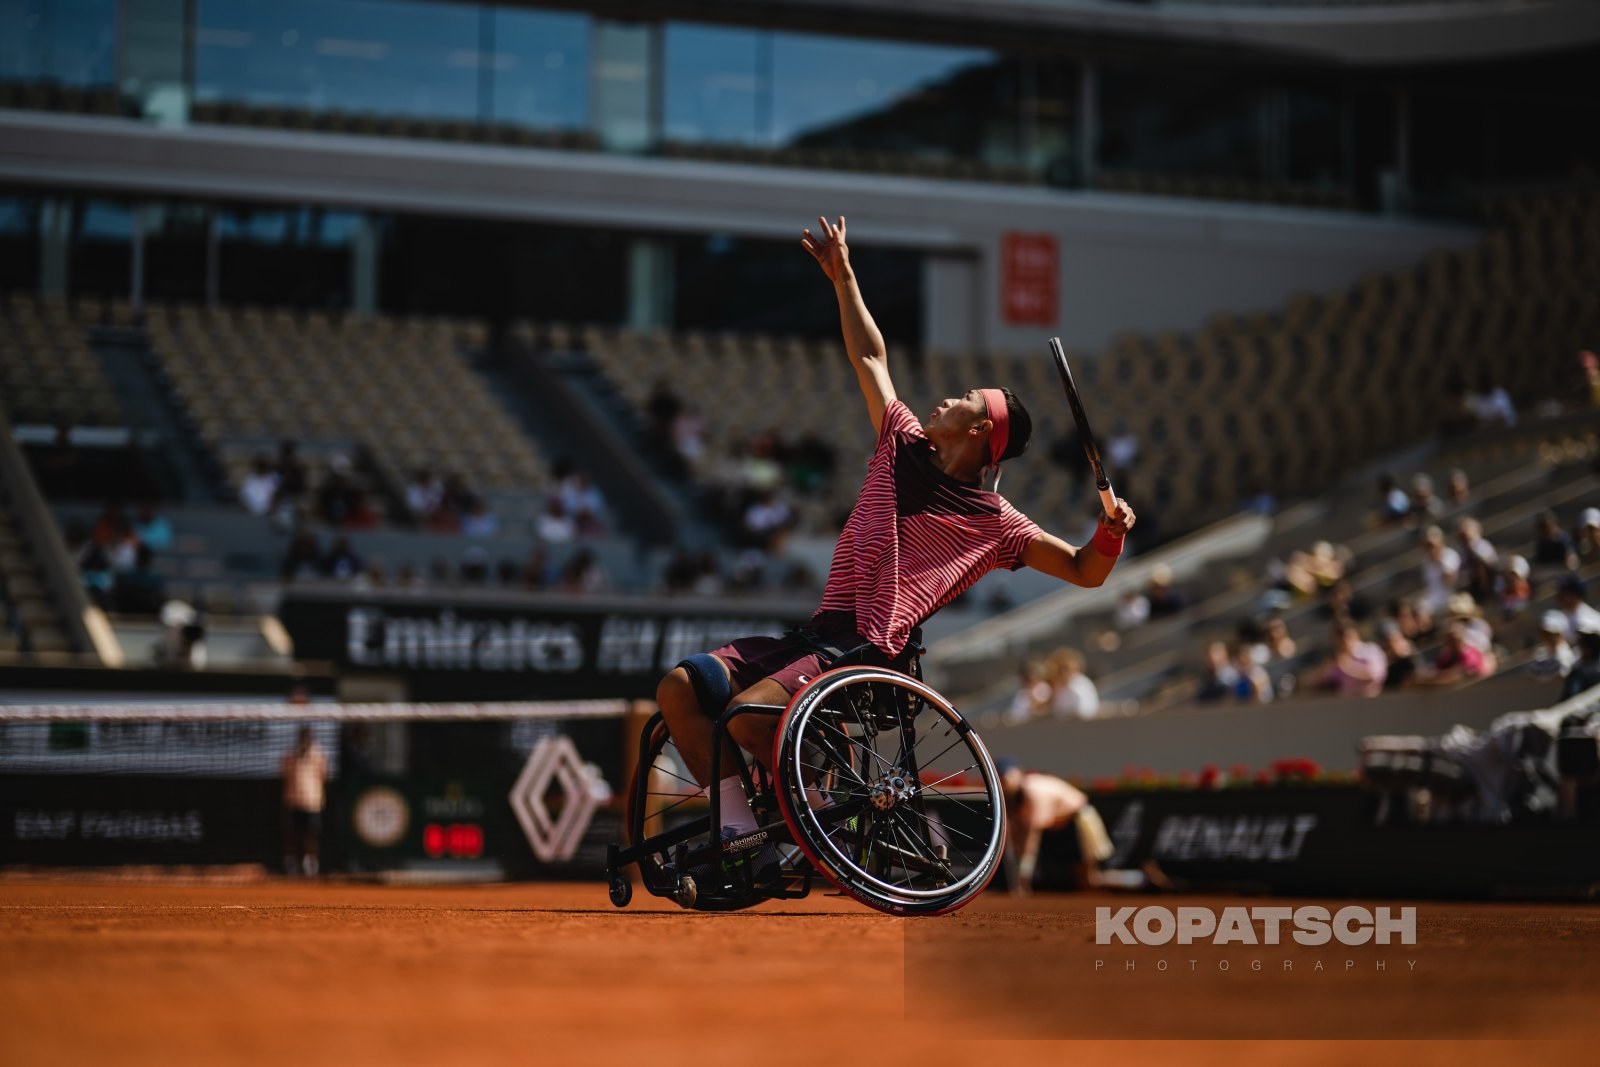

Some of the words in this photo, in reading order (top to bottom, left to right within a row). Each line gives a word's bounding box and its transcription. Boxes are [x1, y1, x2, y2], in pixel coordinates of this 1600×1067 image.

[346, 607, 582, 672] Emirates
[721, 831, 768, 850] HASHIMOTO
[1156, 814, 1316, 861] RENAULT
